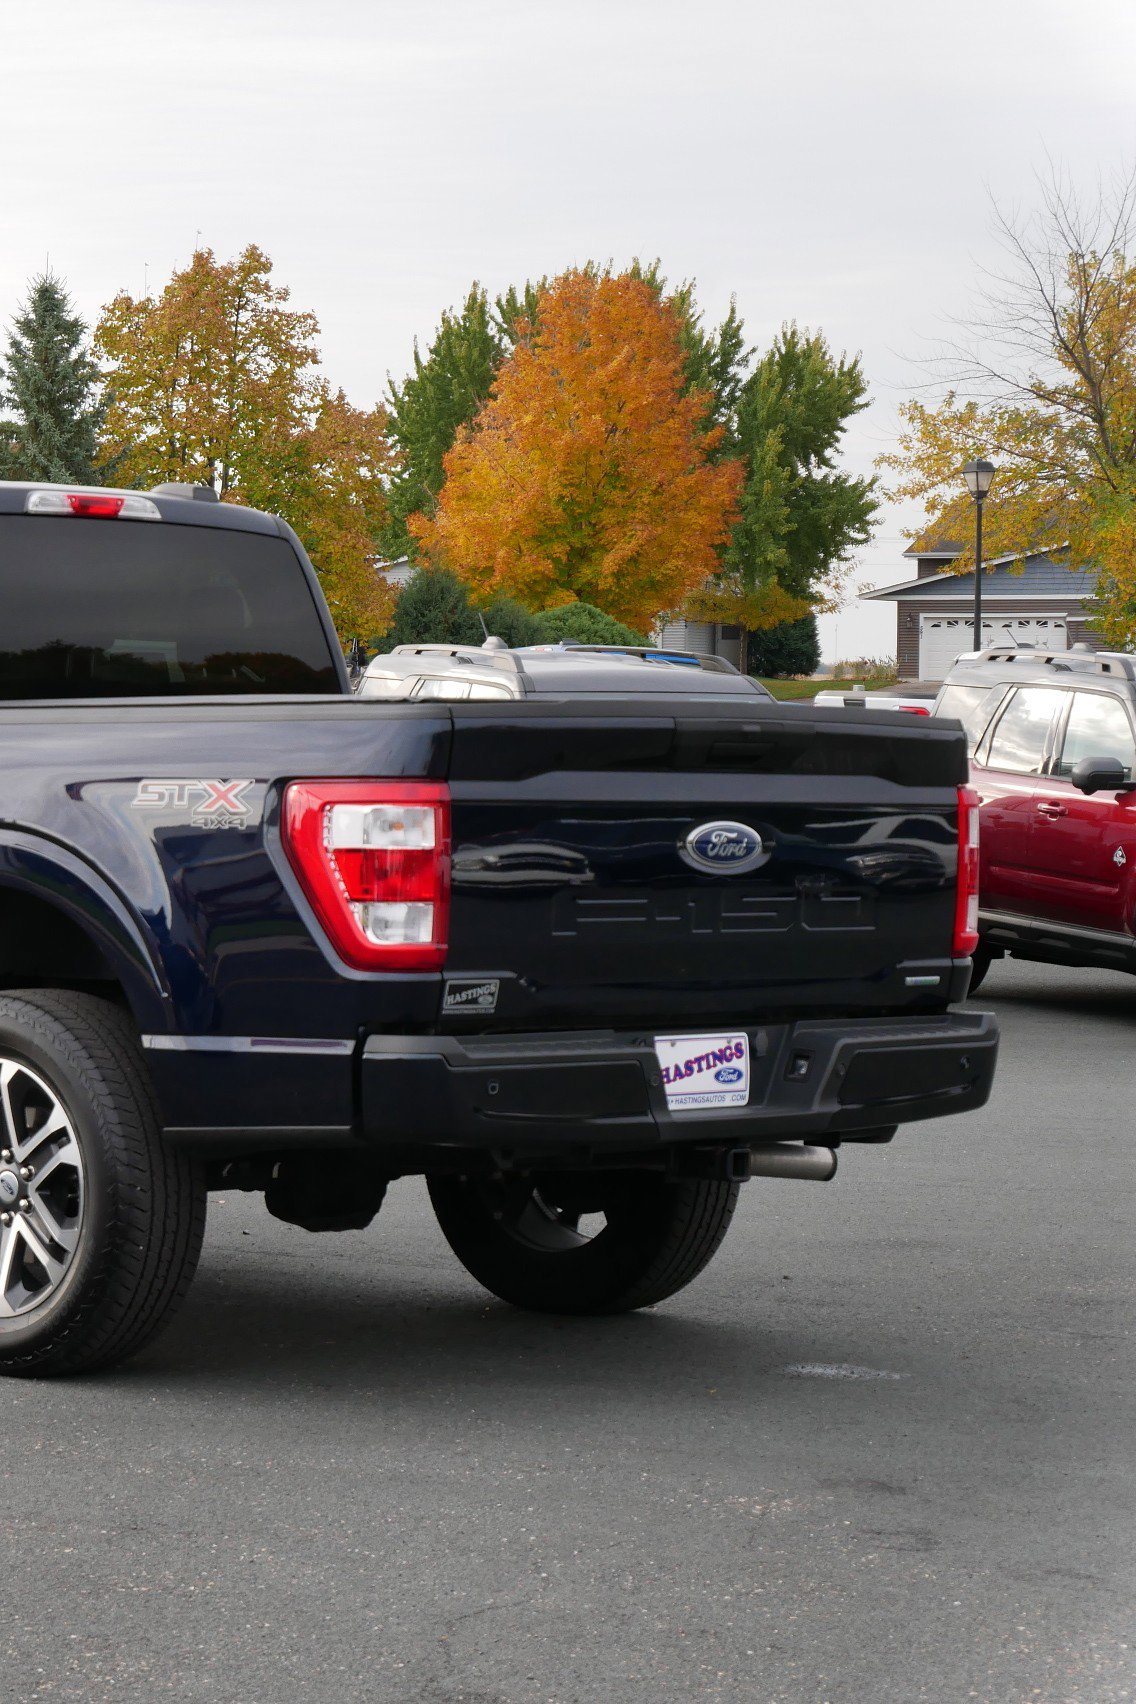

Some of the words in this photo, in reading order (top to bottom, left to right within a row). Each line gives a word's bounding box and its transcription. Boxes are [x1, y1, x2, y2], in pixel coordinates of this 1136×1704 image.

[131, 779, 255, 815] STX
[706, 829, 748, 859] Ford
[447, 983, 497, 1005] HASTINGS
[660, 1041, 745, 1085] HASTINGS
[719, 1068, 740, 1082] Ford
